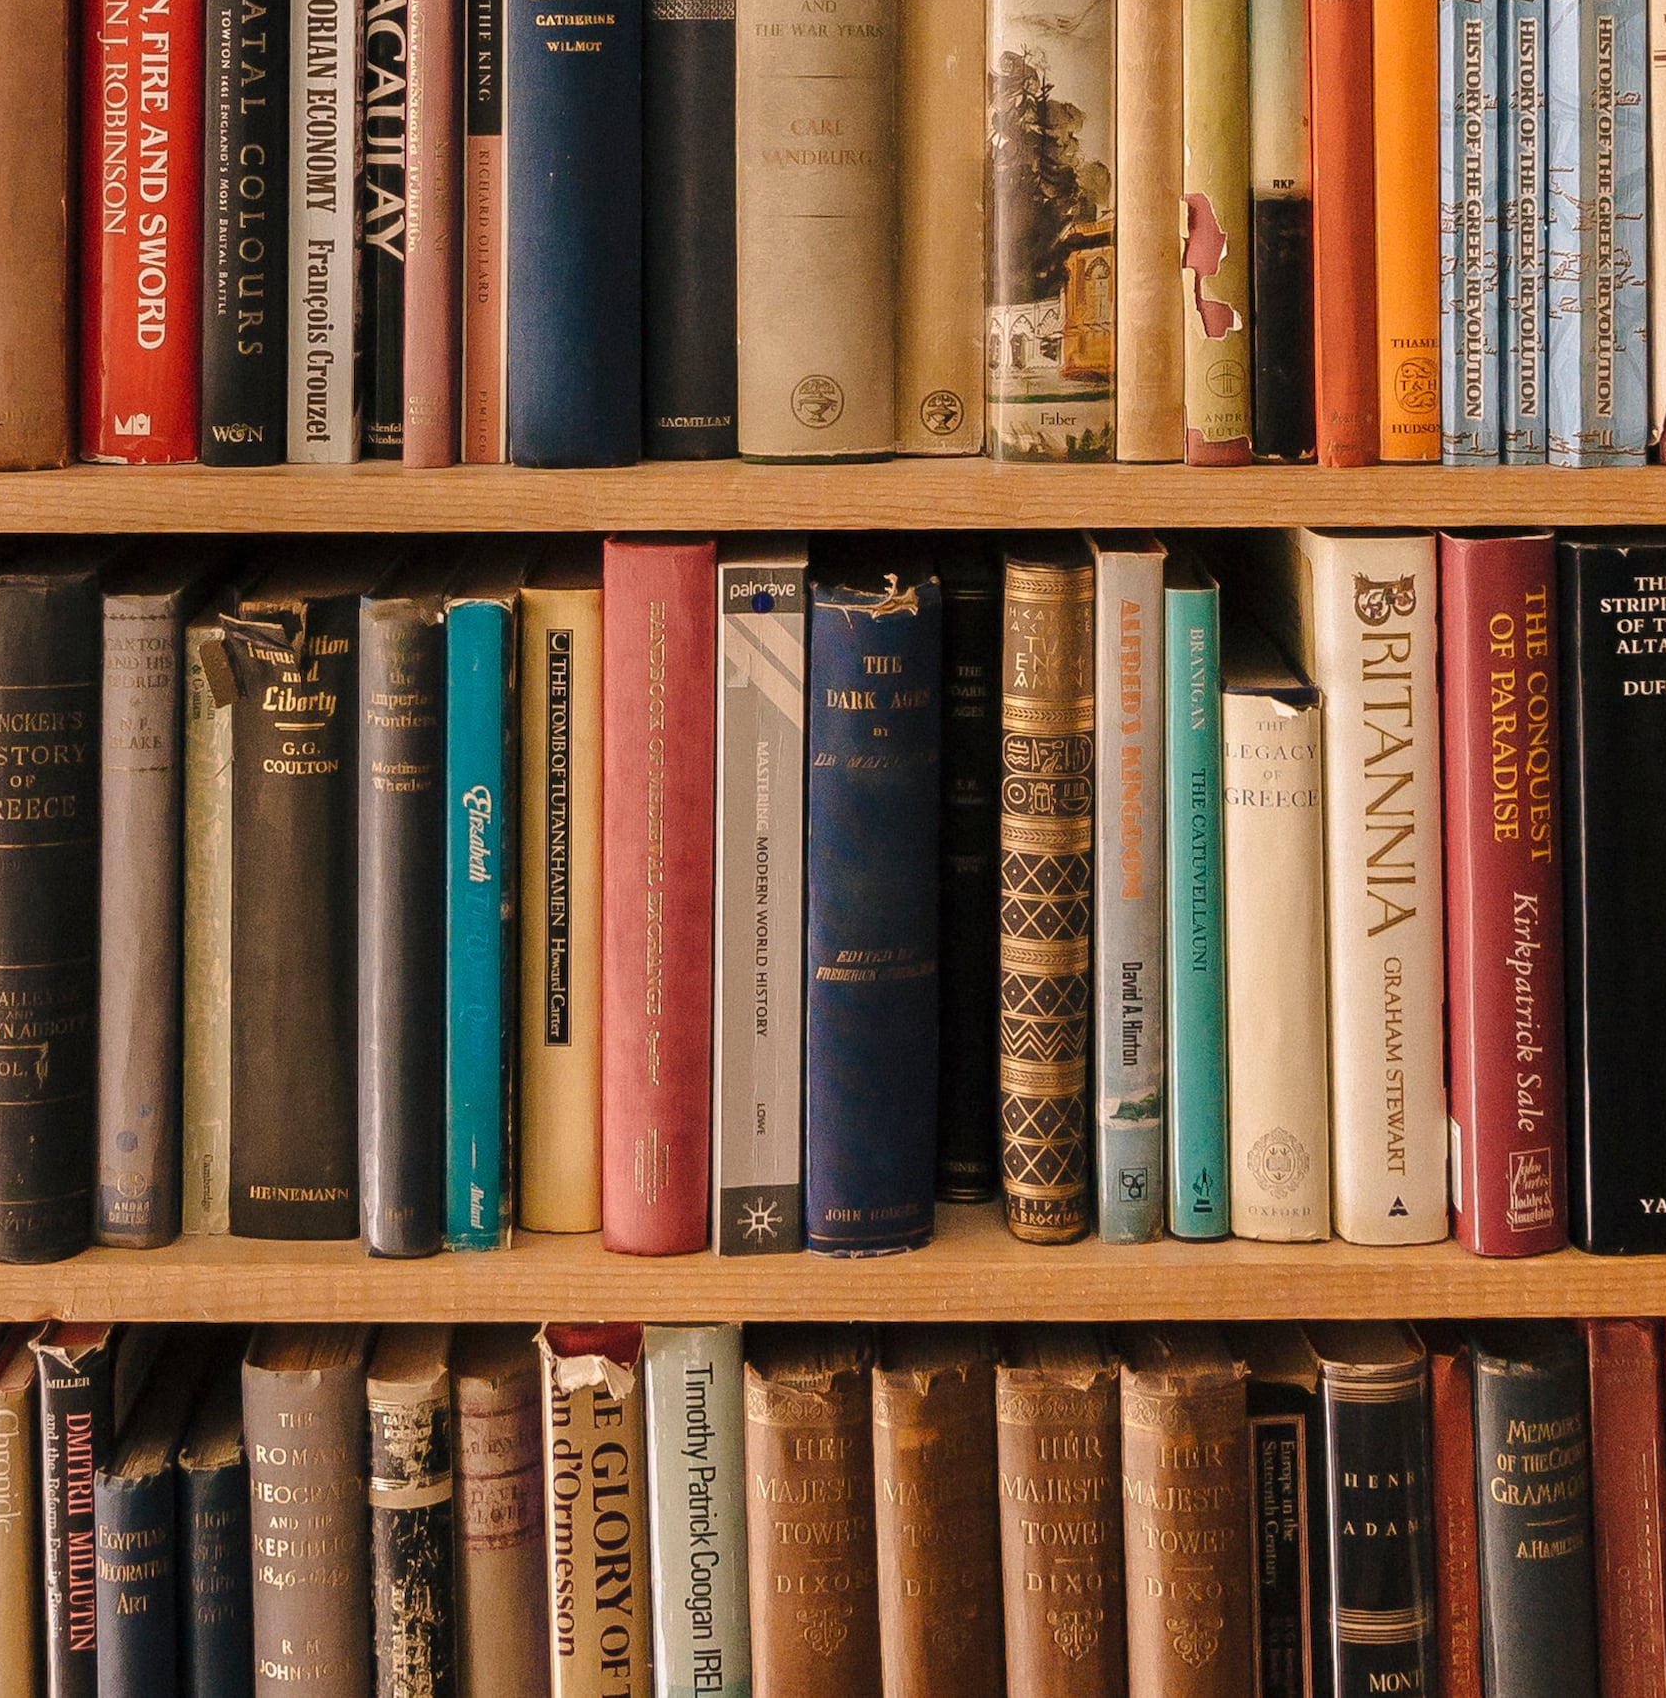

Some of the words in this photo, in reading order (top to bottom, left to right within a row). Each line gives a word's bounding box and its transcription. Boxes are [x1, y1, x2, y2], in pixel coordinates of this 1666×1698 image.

[97, 28, 128, 52] J.
[141, 33, 170, 114] FIRE
[102, 63, 129, 235] ROBINSON
[141, 122, 169, 201] AND
[138, 213, 167, 351] SWORD
[1489, 612, 1514, 662] OF
[1617, 617, 1647, 634] OF
[1353, 572, 1418, 938] BRITANNIA
[1490, 670, 1519, 843] PARADISE
[756, 837, 768, 895] MODERN
[756, 899, 768, 960] WORLD
[756, 966, 767, 1038] HISTORY
[1382, 957, 1405, 1061] GRAHAM
[1506, 893, 1543, 1062] Kirkpatrick
[1385, 1067, 1406, 1175] STEWART
[1516, 1073, 1544, 1132] Sale
[250, 1186, 349, 1201] HEINEMANN
[683, 1361, 714, 1461] Timothy
[687, 1466, 718, 1547] Patrick
[685, 1551, 719, 1641] Coogan
